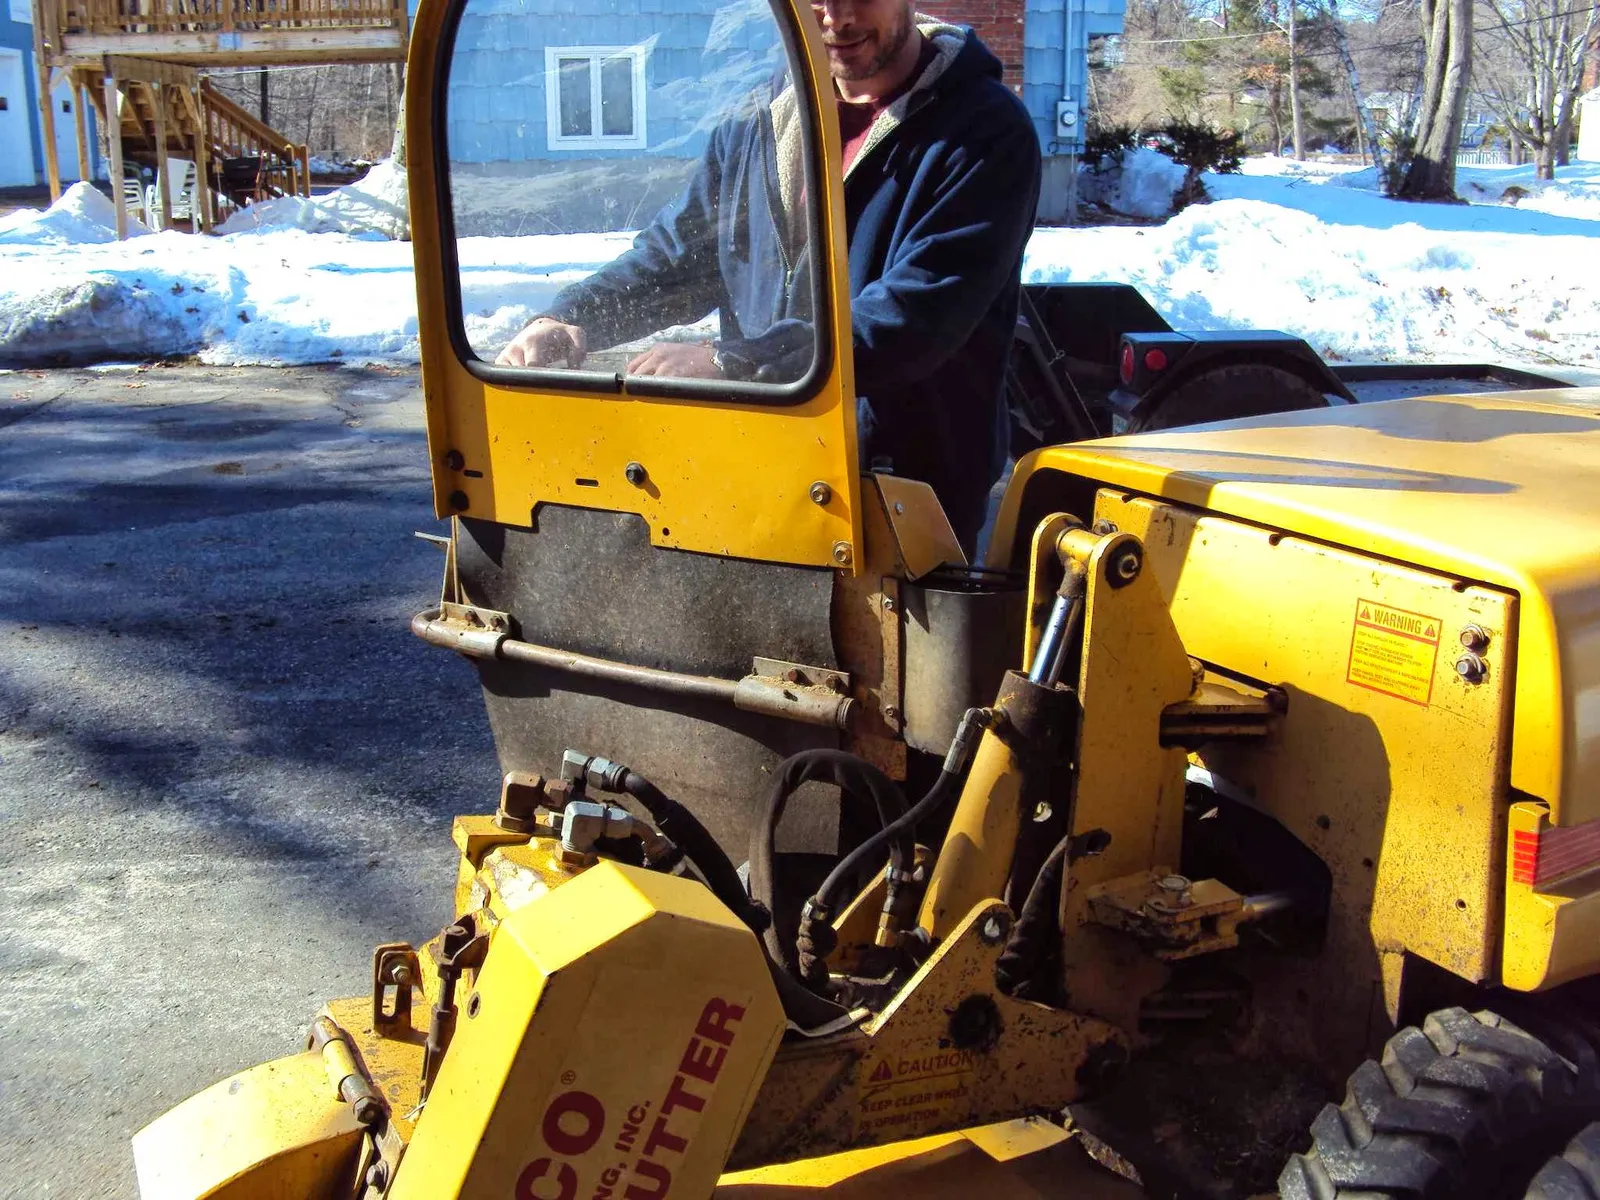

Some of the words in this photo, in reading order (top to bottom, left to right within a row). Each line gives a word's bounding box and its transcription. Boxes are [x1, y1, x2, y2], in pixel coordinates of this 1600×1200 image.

[1374, 609, 1422, 634] WARNING
[897, 1050, 973, 1075] CAUTION
[895, 1093, 932, 1108] CLEAR
[614, 1100, 652, 1153] INC.
